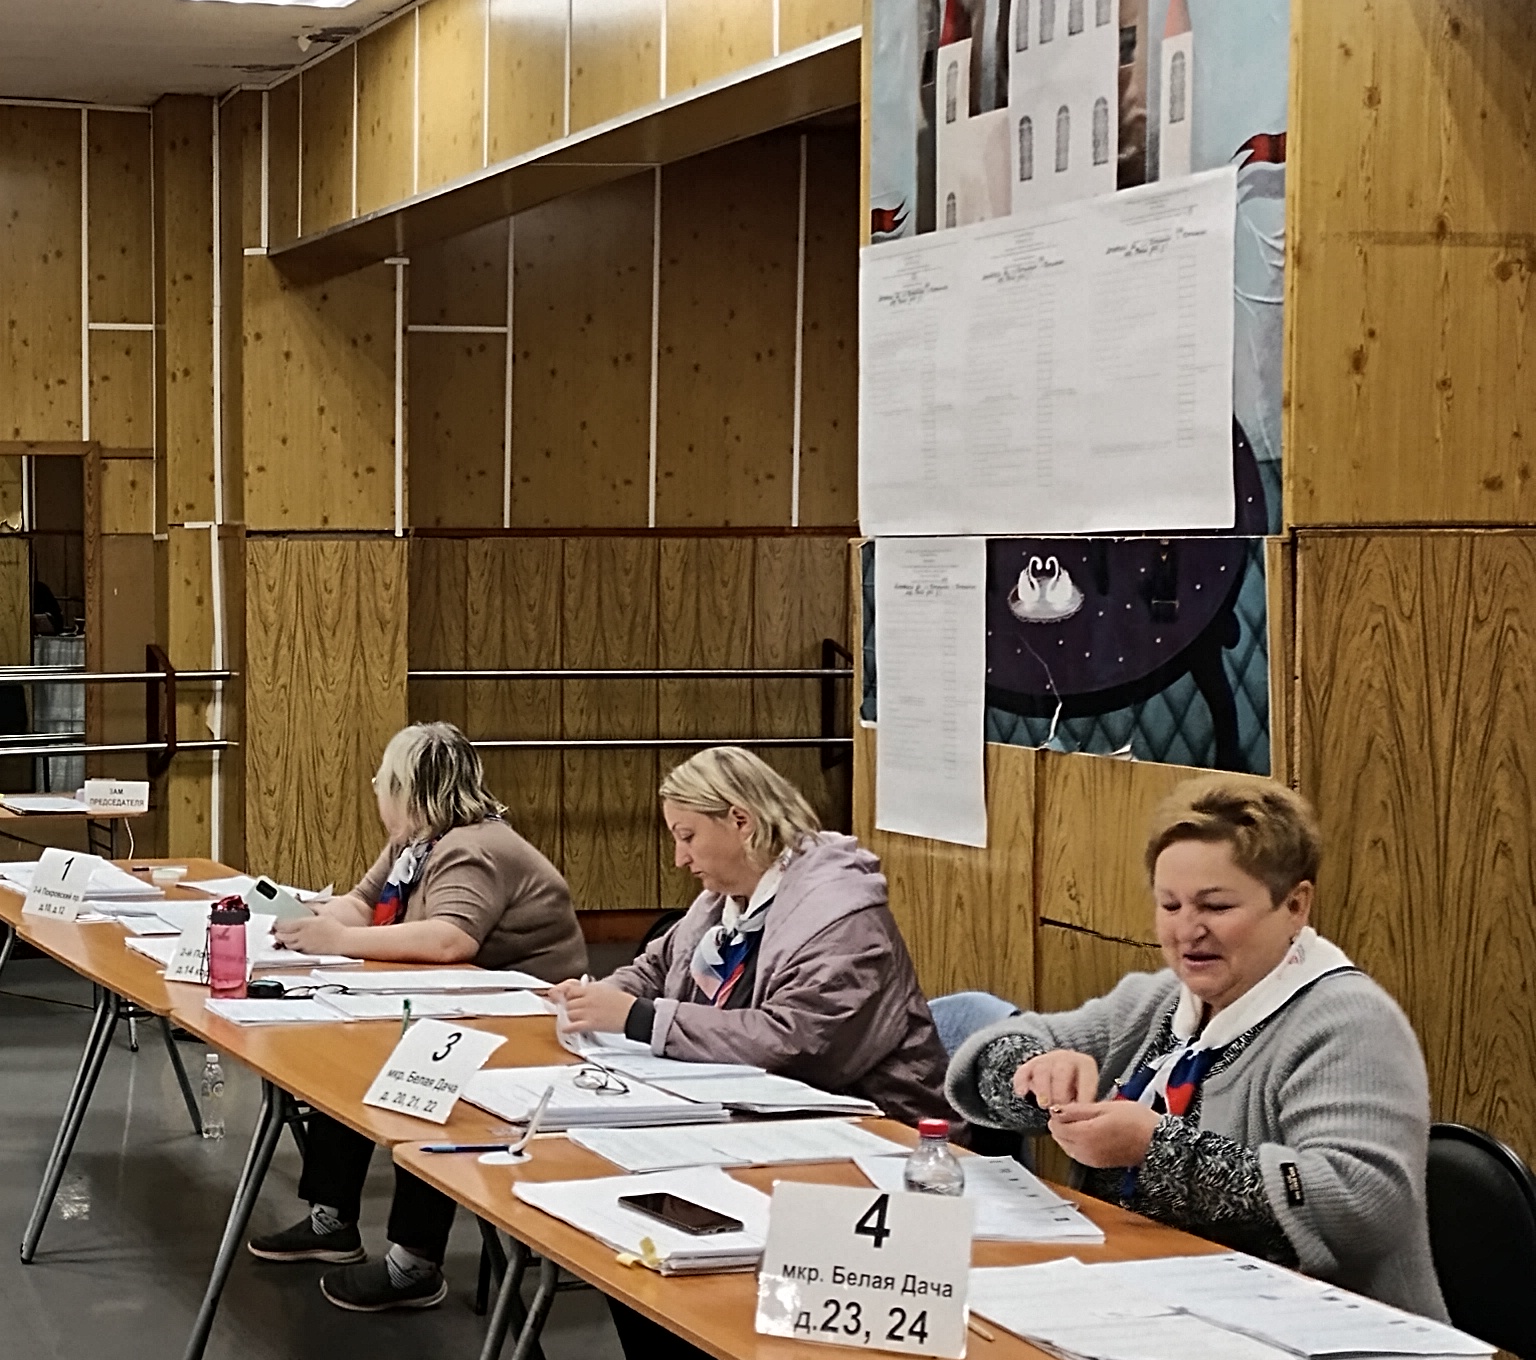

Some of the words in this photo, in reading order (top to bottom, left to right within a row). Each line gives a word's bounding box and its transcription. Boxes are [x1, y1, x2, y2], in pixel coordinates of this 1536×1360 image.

[90, 798, 144, 806] ПРЕДСЕДАТЕЛЯ
[61, 857, 75, 881] 1
[42, 887, 72, 900] Покровский
[432, 1032, 462, 1061] 3
[406, 1071, 435, 1087] Белая
[434, 1078, 459, 1094] Дача
[423, 1100, 438, 1113] 22
[854, 1193, 891, 1248] 4
[781, 1264, 824, 1284] мкр.
[832, 1266, 895, 1290] Белая
[901, 1274, 953, 1298] Дача
[794, 1299, 871, 1344] д.23,
[885, 1307, 929, 1345] 24
